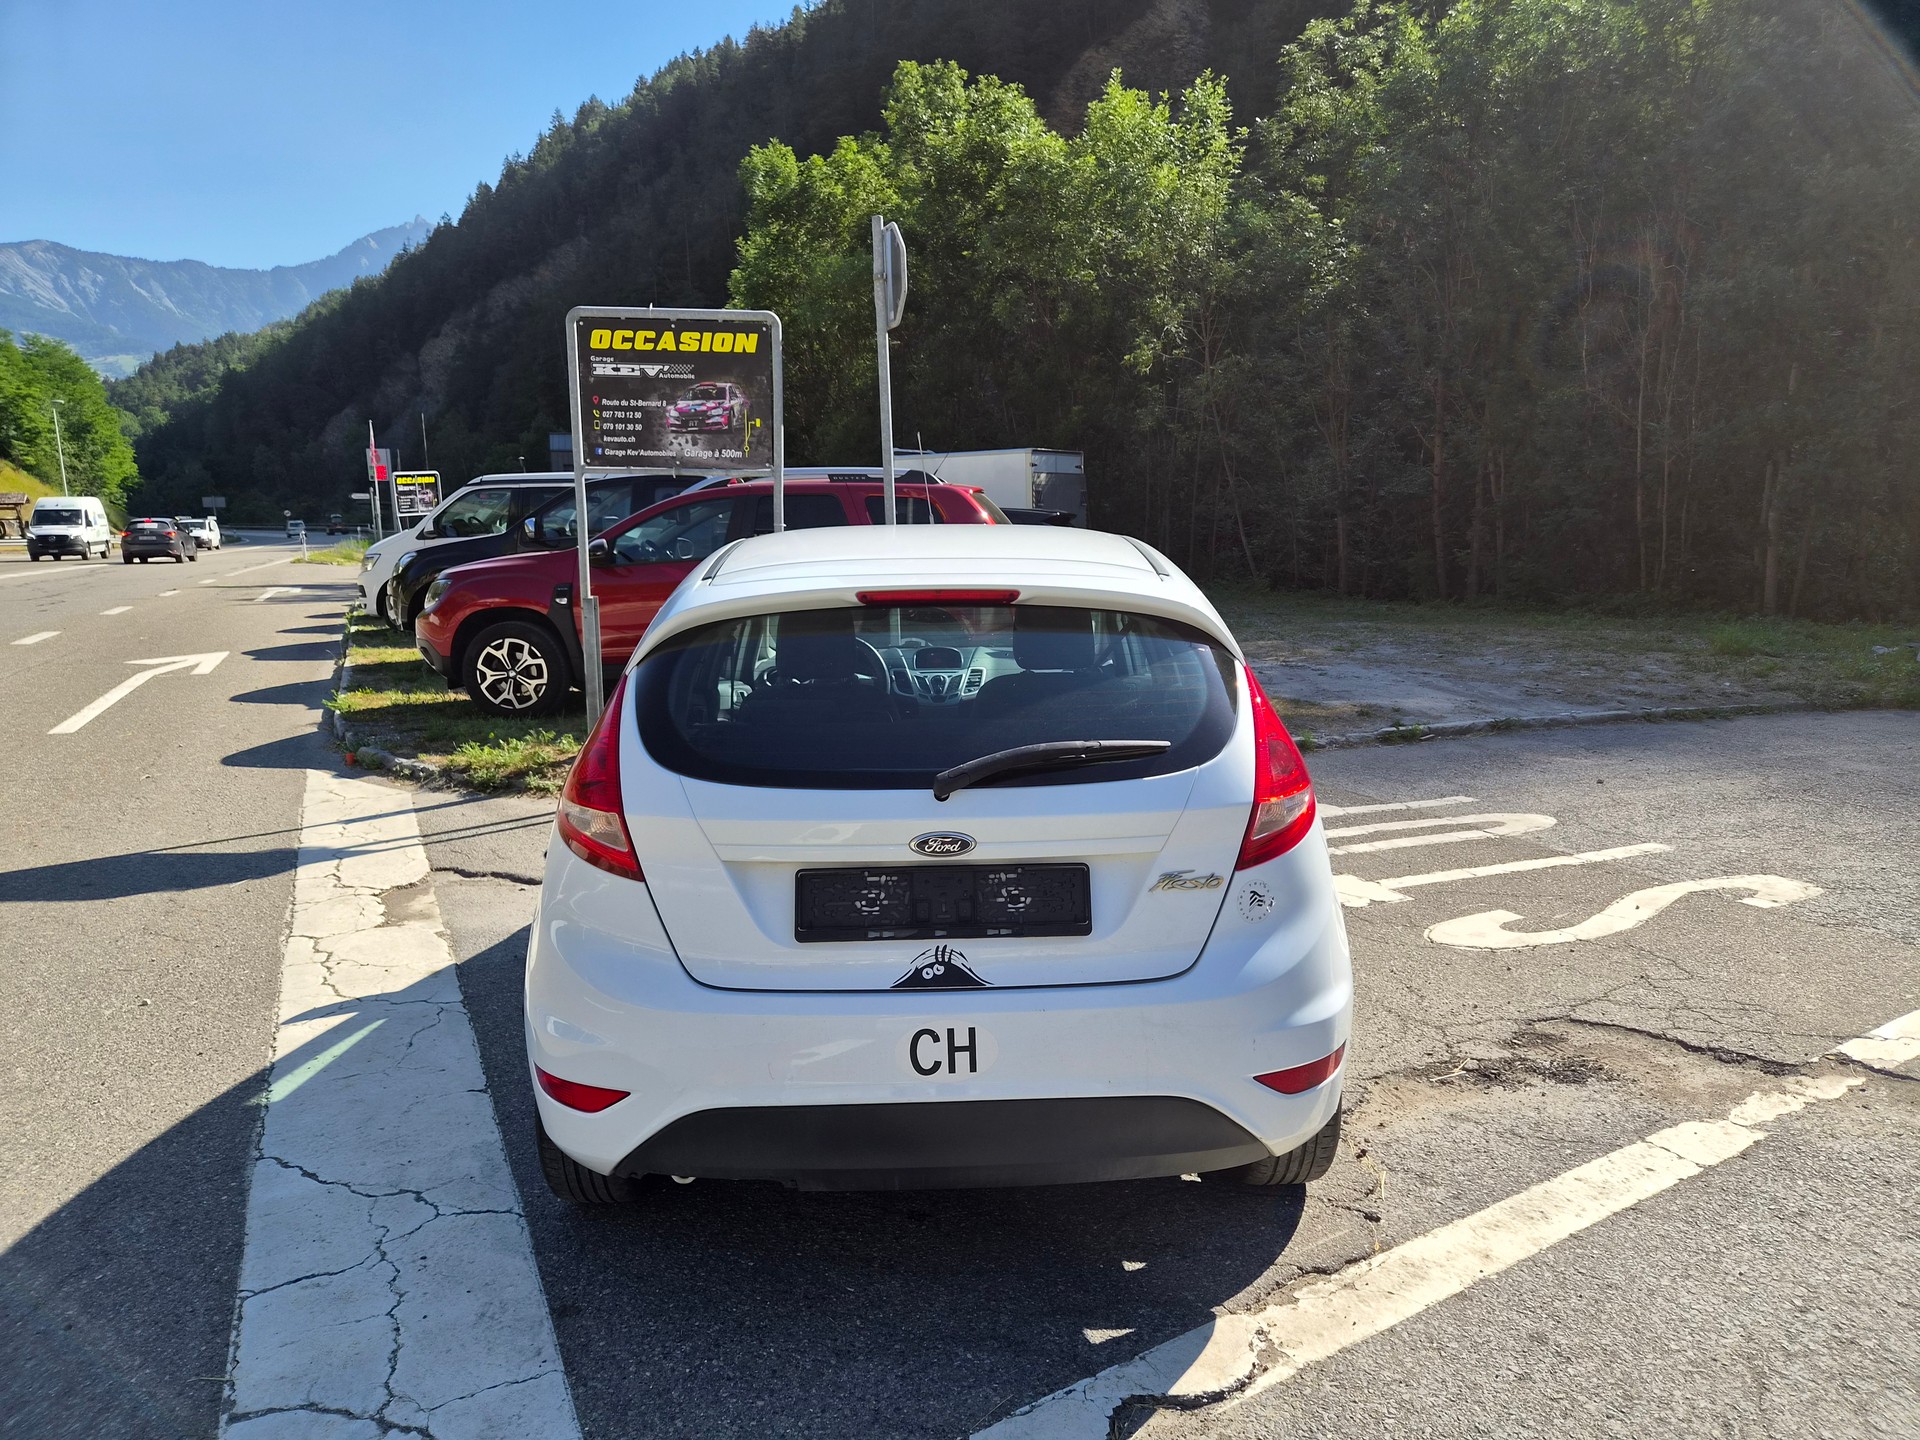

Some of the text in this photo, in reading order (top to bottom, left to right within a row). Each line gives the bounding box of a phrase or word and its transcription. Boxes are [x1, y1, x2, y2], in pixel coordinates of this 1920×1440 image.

[589, 329, 758, 353] OCCASION
[658, 372, 695, 380] Automobile
[601, 398, 620, 406] Route
[629, 399, 661, 407] St-Bernard
[626, 411, 633, 419] 12
[603, 435, 636, 443] kevauto.ch
[604, 448, 626, 457] Garage
[684, 448, 743, 459] Garage à 500m
[924, 837, 962, 853] Ford
[1147, 868, 1224, 894] Fiesta
[908, 1026, 978, 1076] CH
